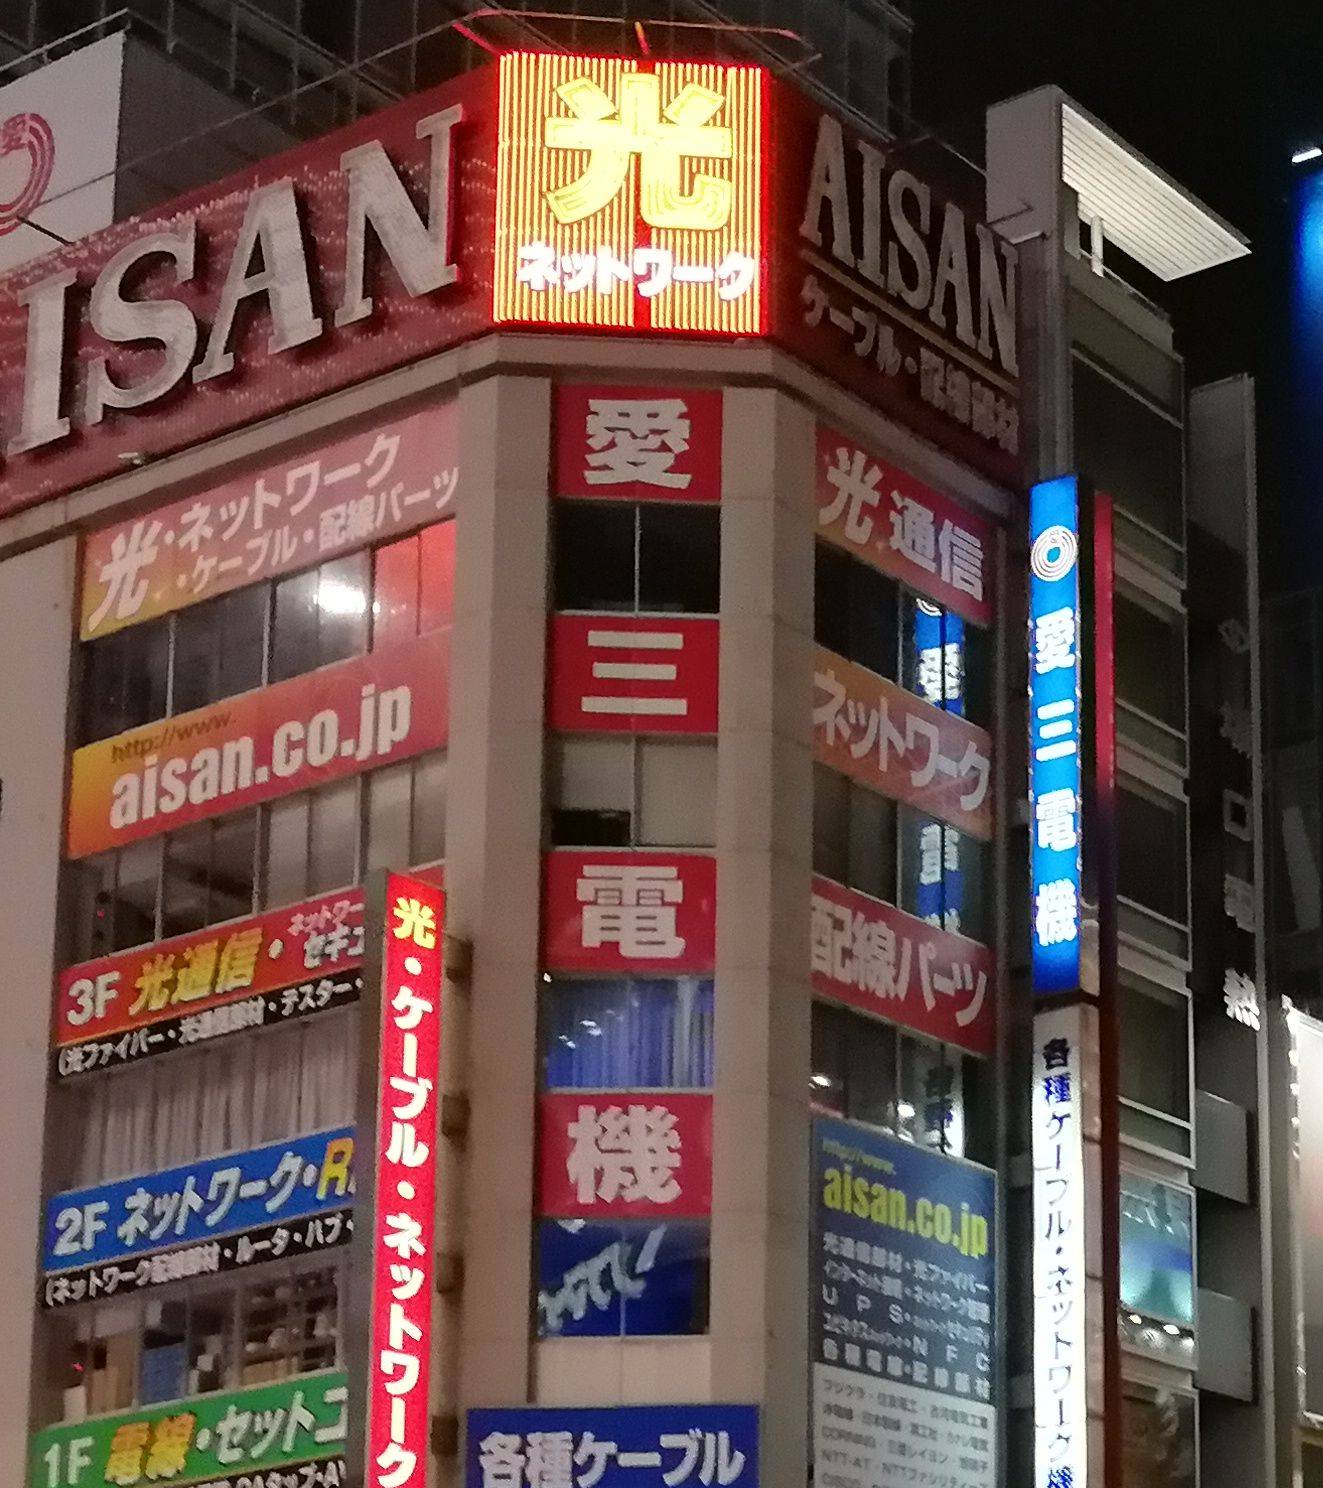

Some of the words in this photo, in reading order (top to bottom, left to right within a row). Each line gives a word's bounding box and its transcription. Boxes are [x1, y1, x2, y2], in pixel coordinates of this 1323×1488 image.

[545, 73, 733, 231] 光
[516, 241, 755, 300] ネットワーク
[800, 114, 1019, 377] AISAN
[584, 398, 691, 489] 愛
[819, 447, 984, 602] 光通信
[581, 630, 688, 715] 三
[108, 683, 412, 831] aisan.co.jp
[813, 668, 992, 812] ネットワーク
[1036, 606, 1077, 949] 愛三電機
[577, 866, 685, 959] 電
[810, 898, 987, 1027] 配線パーツ
[67, 970, 120, 1025] 3F
[376, 896, 437, 1488] 光・ケーブル・ネットワーク
[566, 1104, 682, 1205] 機
[53, 1201, 110, 1257] 2F
[822, 1163, 989, 1259] aisan.co.jp
[44, 1436, 95, 1488] 1F
